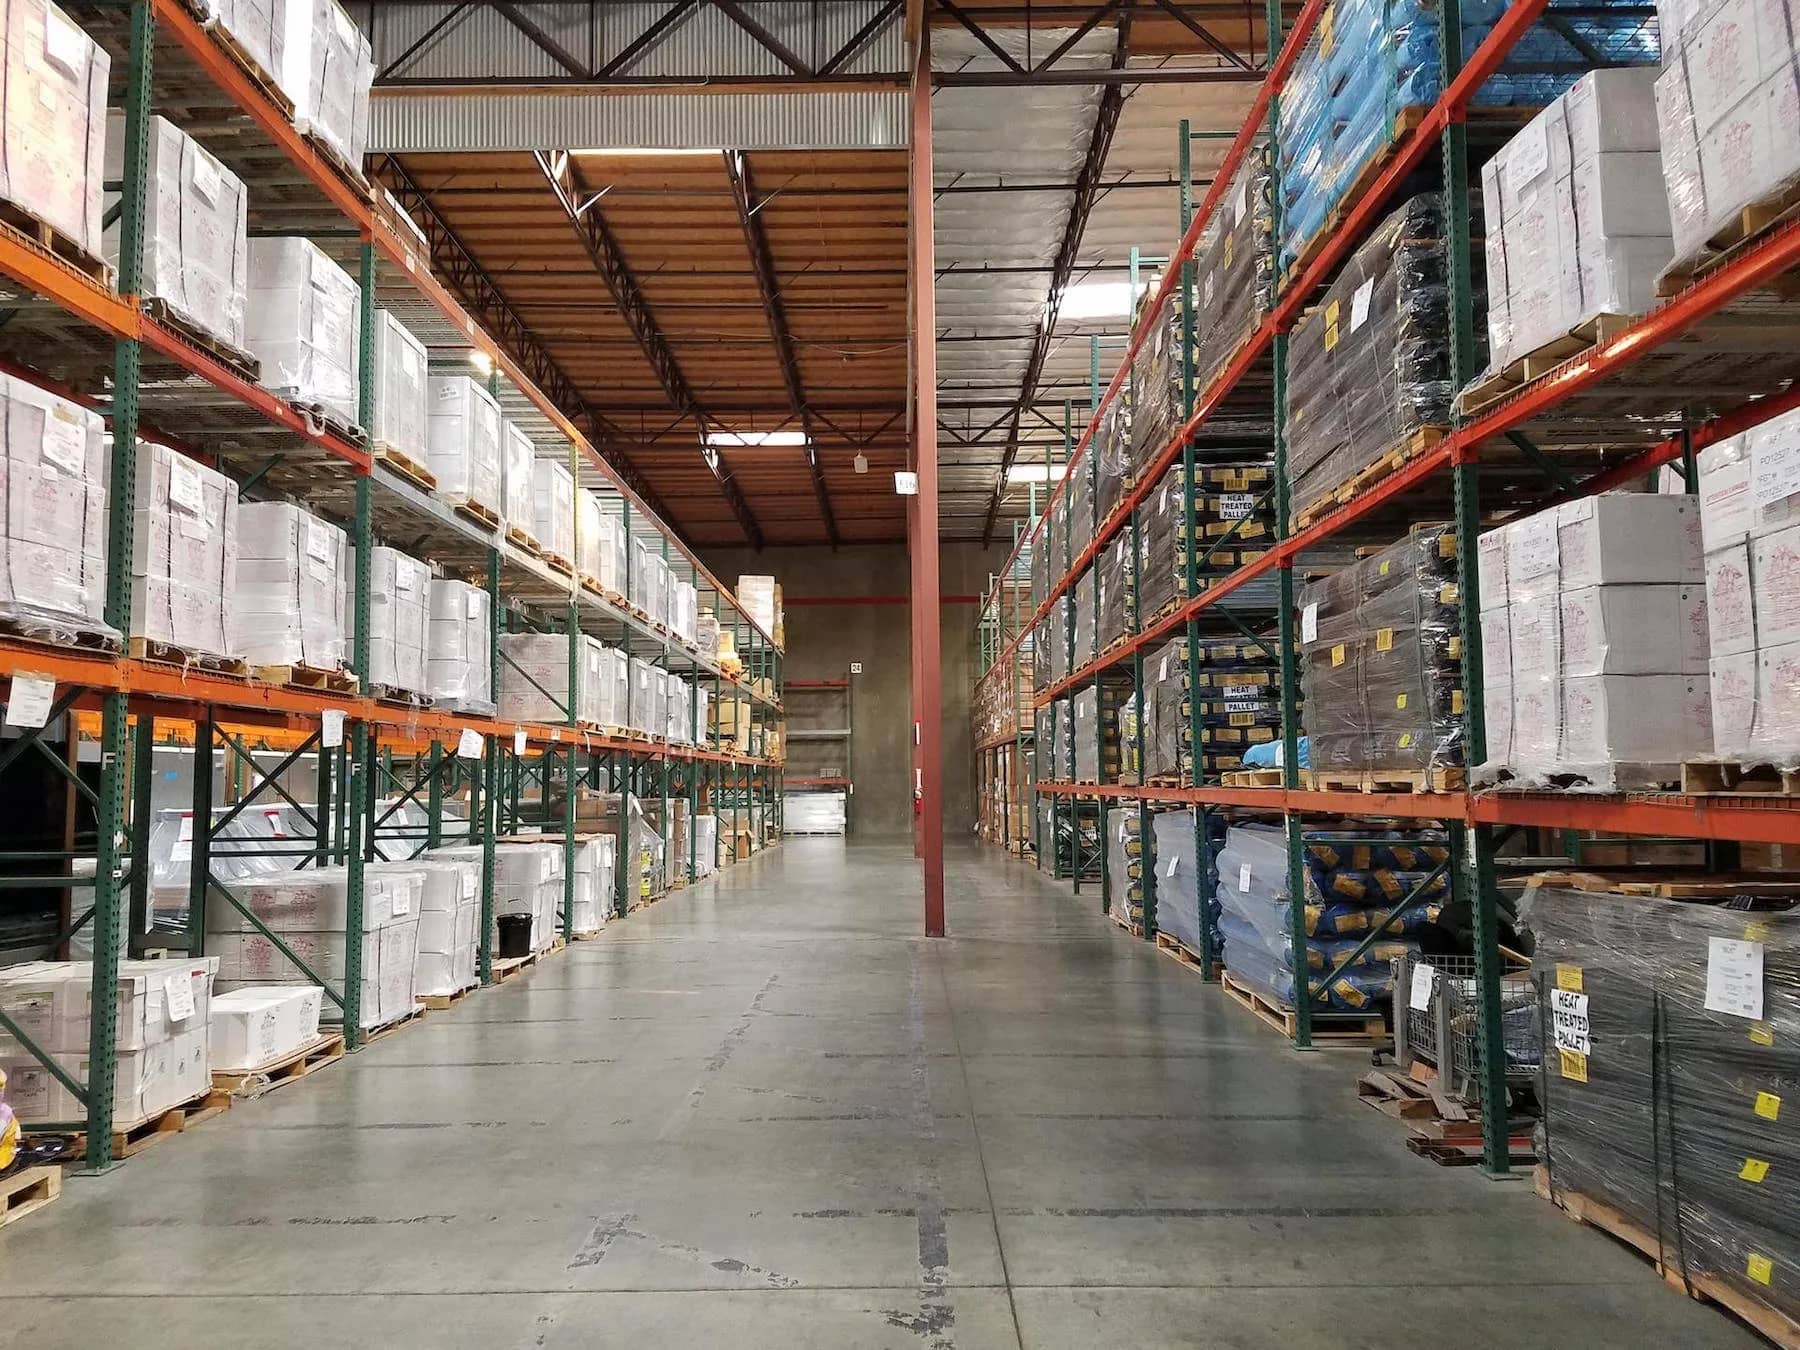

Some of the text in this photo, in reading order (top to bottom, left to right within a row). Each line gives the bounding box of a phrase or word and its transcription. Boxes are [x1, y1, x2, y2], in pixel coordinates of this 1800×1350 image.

[1559, 992, 1580, 1009] HEAT
[1554, 1010, 1588, 1031] TREATED
[1558, 1030, 1585, 1052] PALLET
